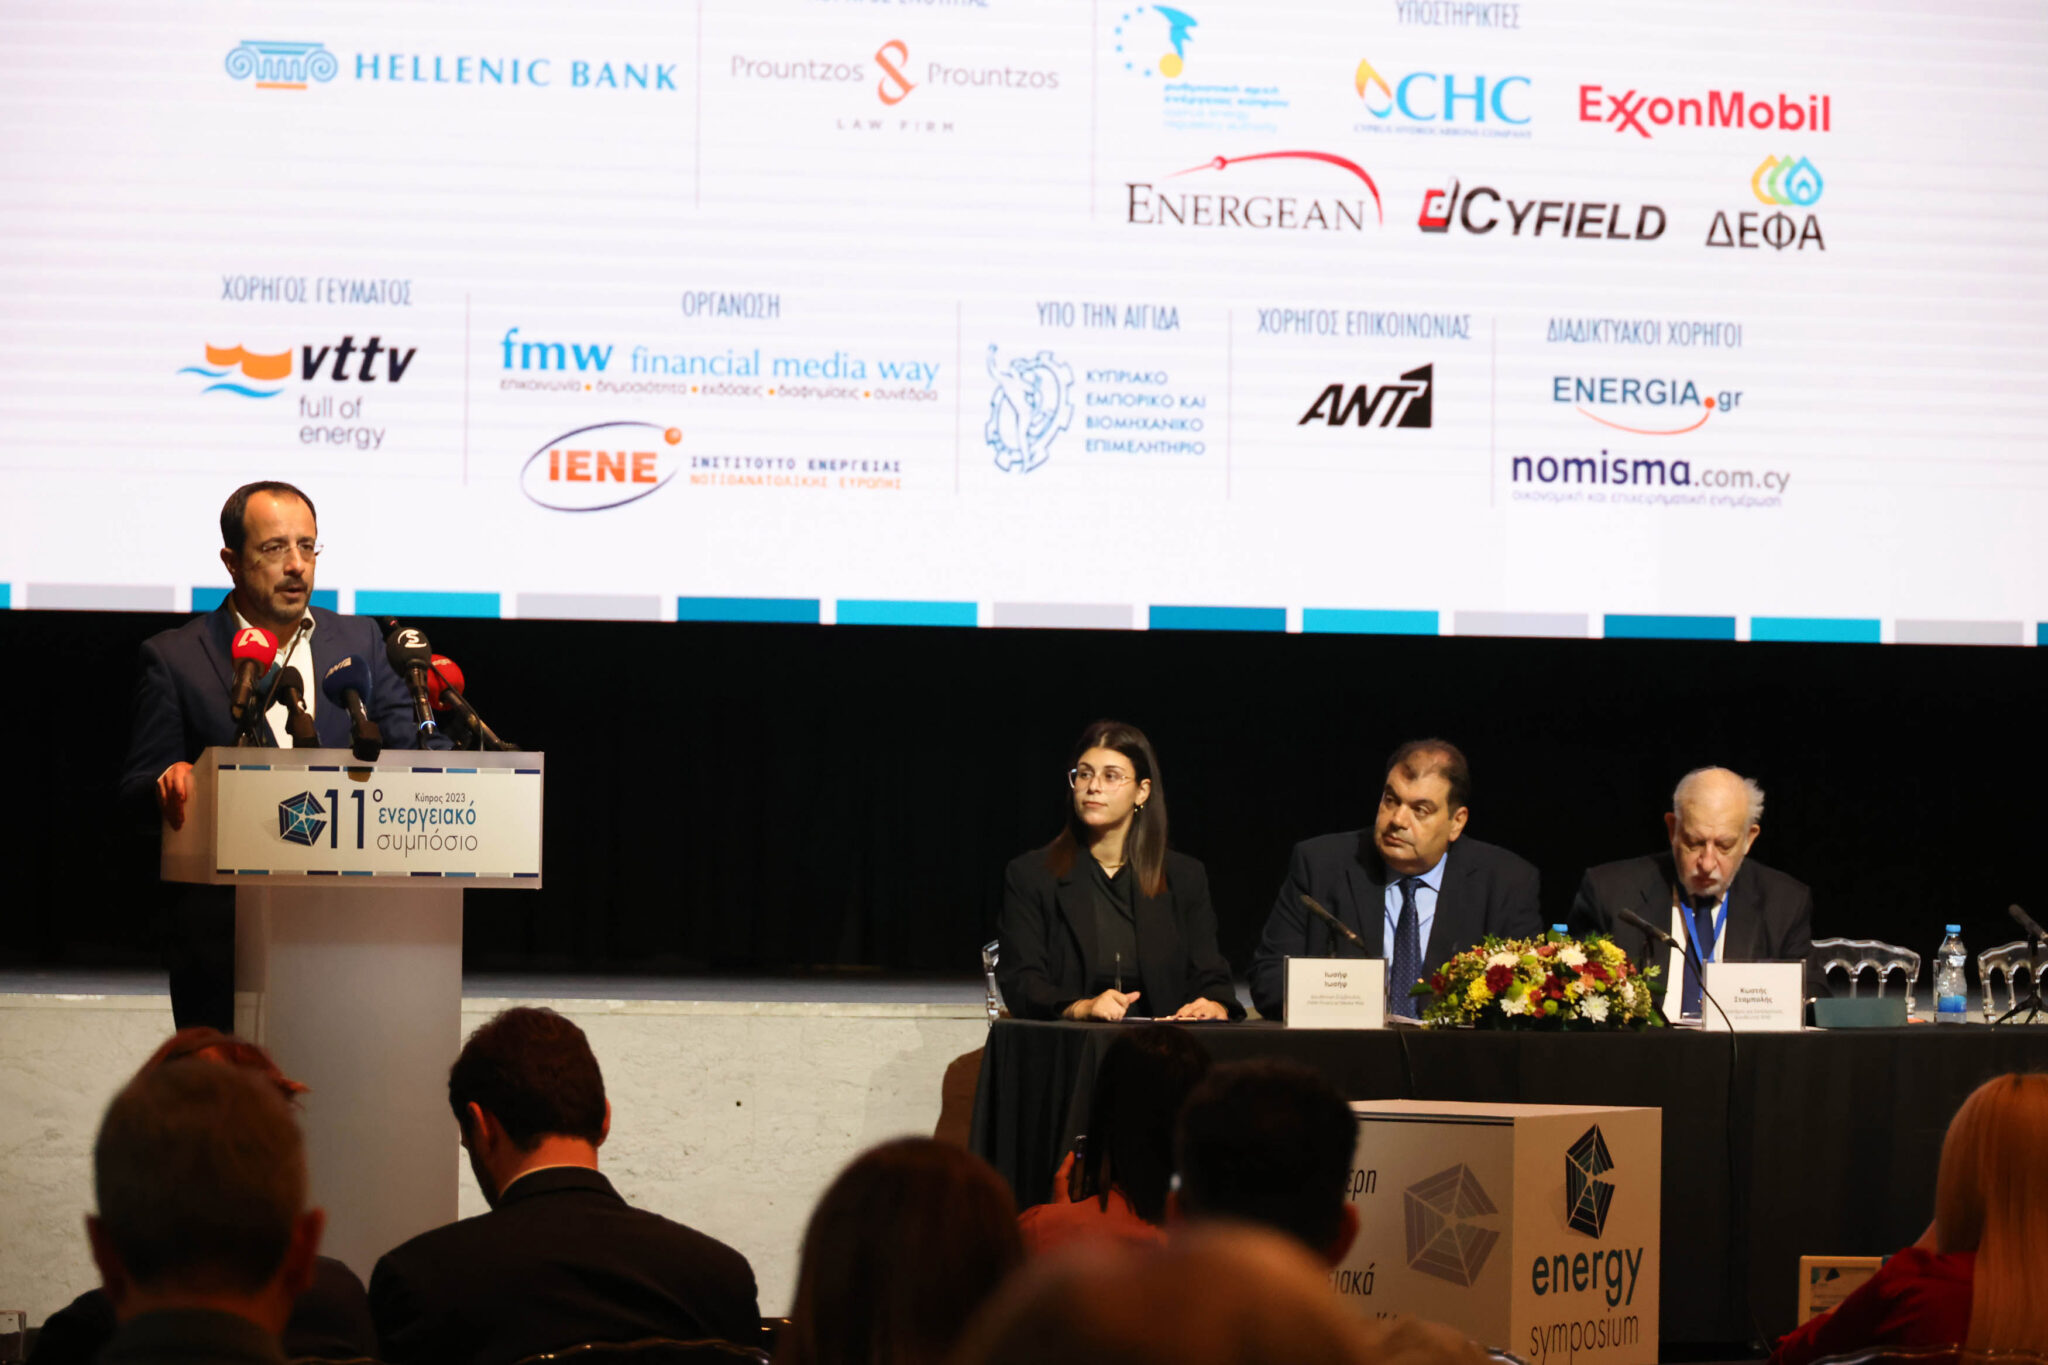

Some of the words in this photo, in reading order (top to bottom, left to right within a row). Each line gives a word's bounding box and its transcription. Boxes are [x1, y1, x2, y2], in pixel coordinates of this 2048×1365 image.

[355, 53, 551, 86] HELLENIC
[571, 60, 678, 91] BANK
[731, 54, 864, 82] Prountzos
[928, 62, 1060, 89] Prountzos
[1396, 71, 1532, 124] CHC
[1578, 84, 1831, 139] ExxonMobil
[837, 119, 882, 131] LAW
[901, 120, 954, 132] FIRM
[1705, 209, 1826, 252] ΔΕΦΑ
[221, 275, 307, 303] ΧΟΡΗΓΟΣ
[316, 278, 412, 306] ΓΕΥΜΑΤΟΣ
[682, 291, 780, 319] ΟΡΓΑΝΩΣΗ
[1037, 301, 1075, 328] ΥΠΟ
[1083, 302, 1117, 328] ΤΗΝ
[1124, 304, 1180, 330] ΑΙΓΙΔΑ
[1257, 308, 1339, 336] ΧΟΡΗΓΟΣ
[1347, 310, 1471, 339] ΕΠΙΚΟΙΝΩΝΙΑΣ
[1547, 317, 1661, 345] ΔΙΑΔΙΚΤΥΑΚΟΙ
[1667, 321, 1742, 348] ΧΟΡΗΓΟΙ
[302, 335, 417, 383] vttv
[500, 327, 613, 372] fmw
[631, 346, 760, 378] financial
[773, 351, 866, 381] media
[878, 361, 940, 390] way
[1087, 370, 1168, 385] ΚΥΠΡΙΑΚΟ
[300, 395, 333, 418] full
[339, 396, 363, 419] of
[1086, 393, 1174, 408] ΕΜΠΟΡΙΚΟ
[1180, 395, 1206, 409] ΚΑΙ
[300, 425, 385, 449] energy
[1512, 449, 1790, 493] nomisma.com.cy
[415, 792, 443, 805] Κύπρος
[445, 792, 466, 803] 2023
[378, 800, 477, 832] ενεργειακό
[376, 828, 478, 858] συμπόσιο
[1532, 1247, 1643, 1307] energy
[1530, 1307, 1639, 1365] symposium
